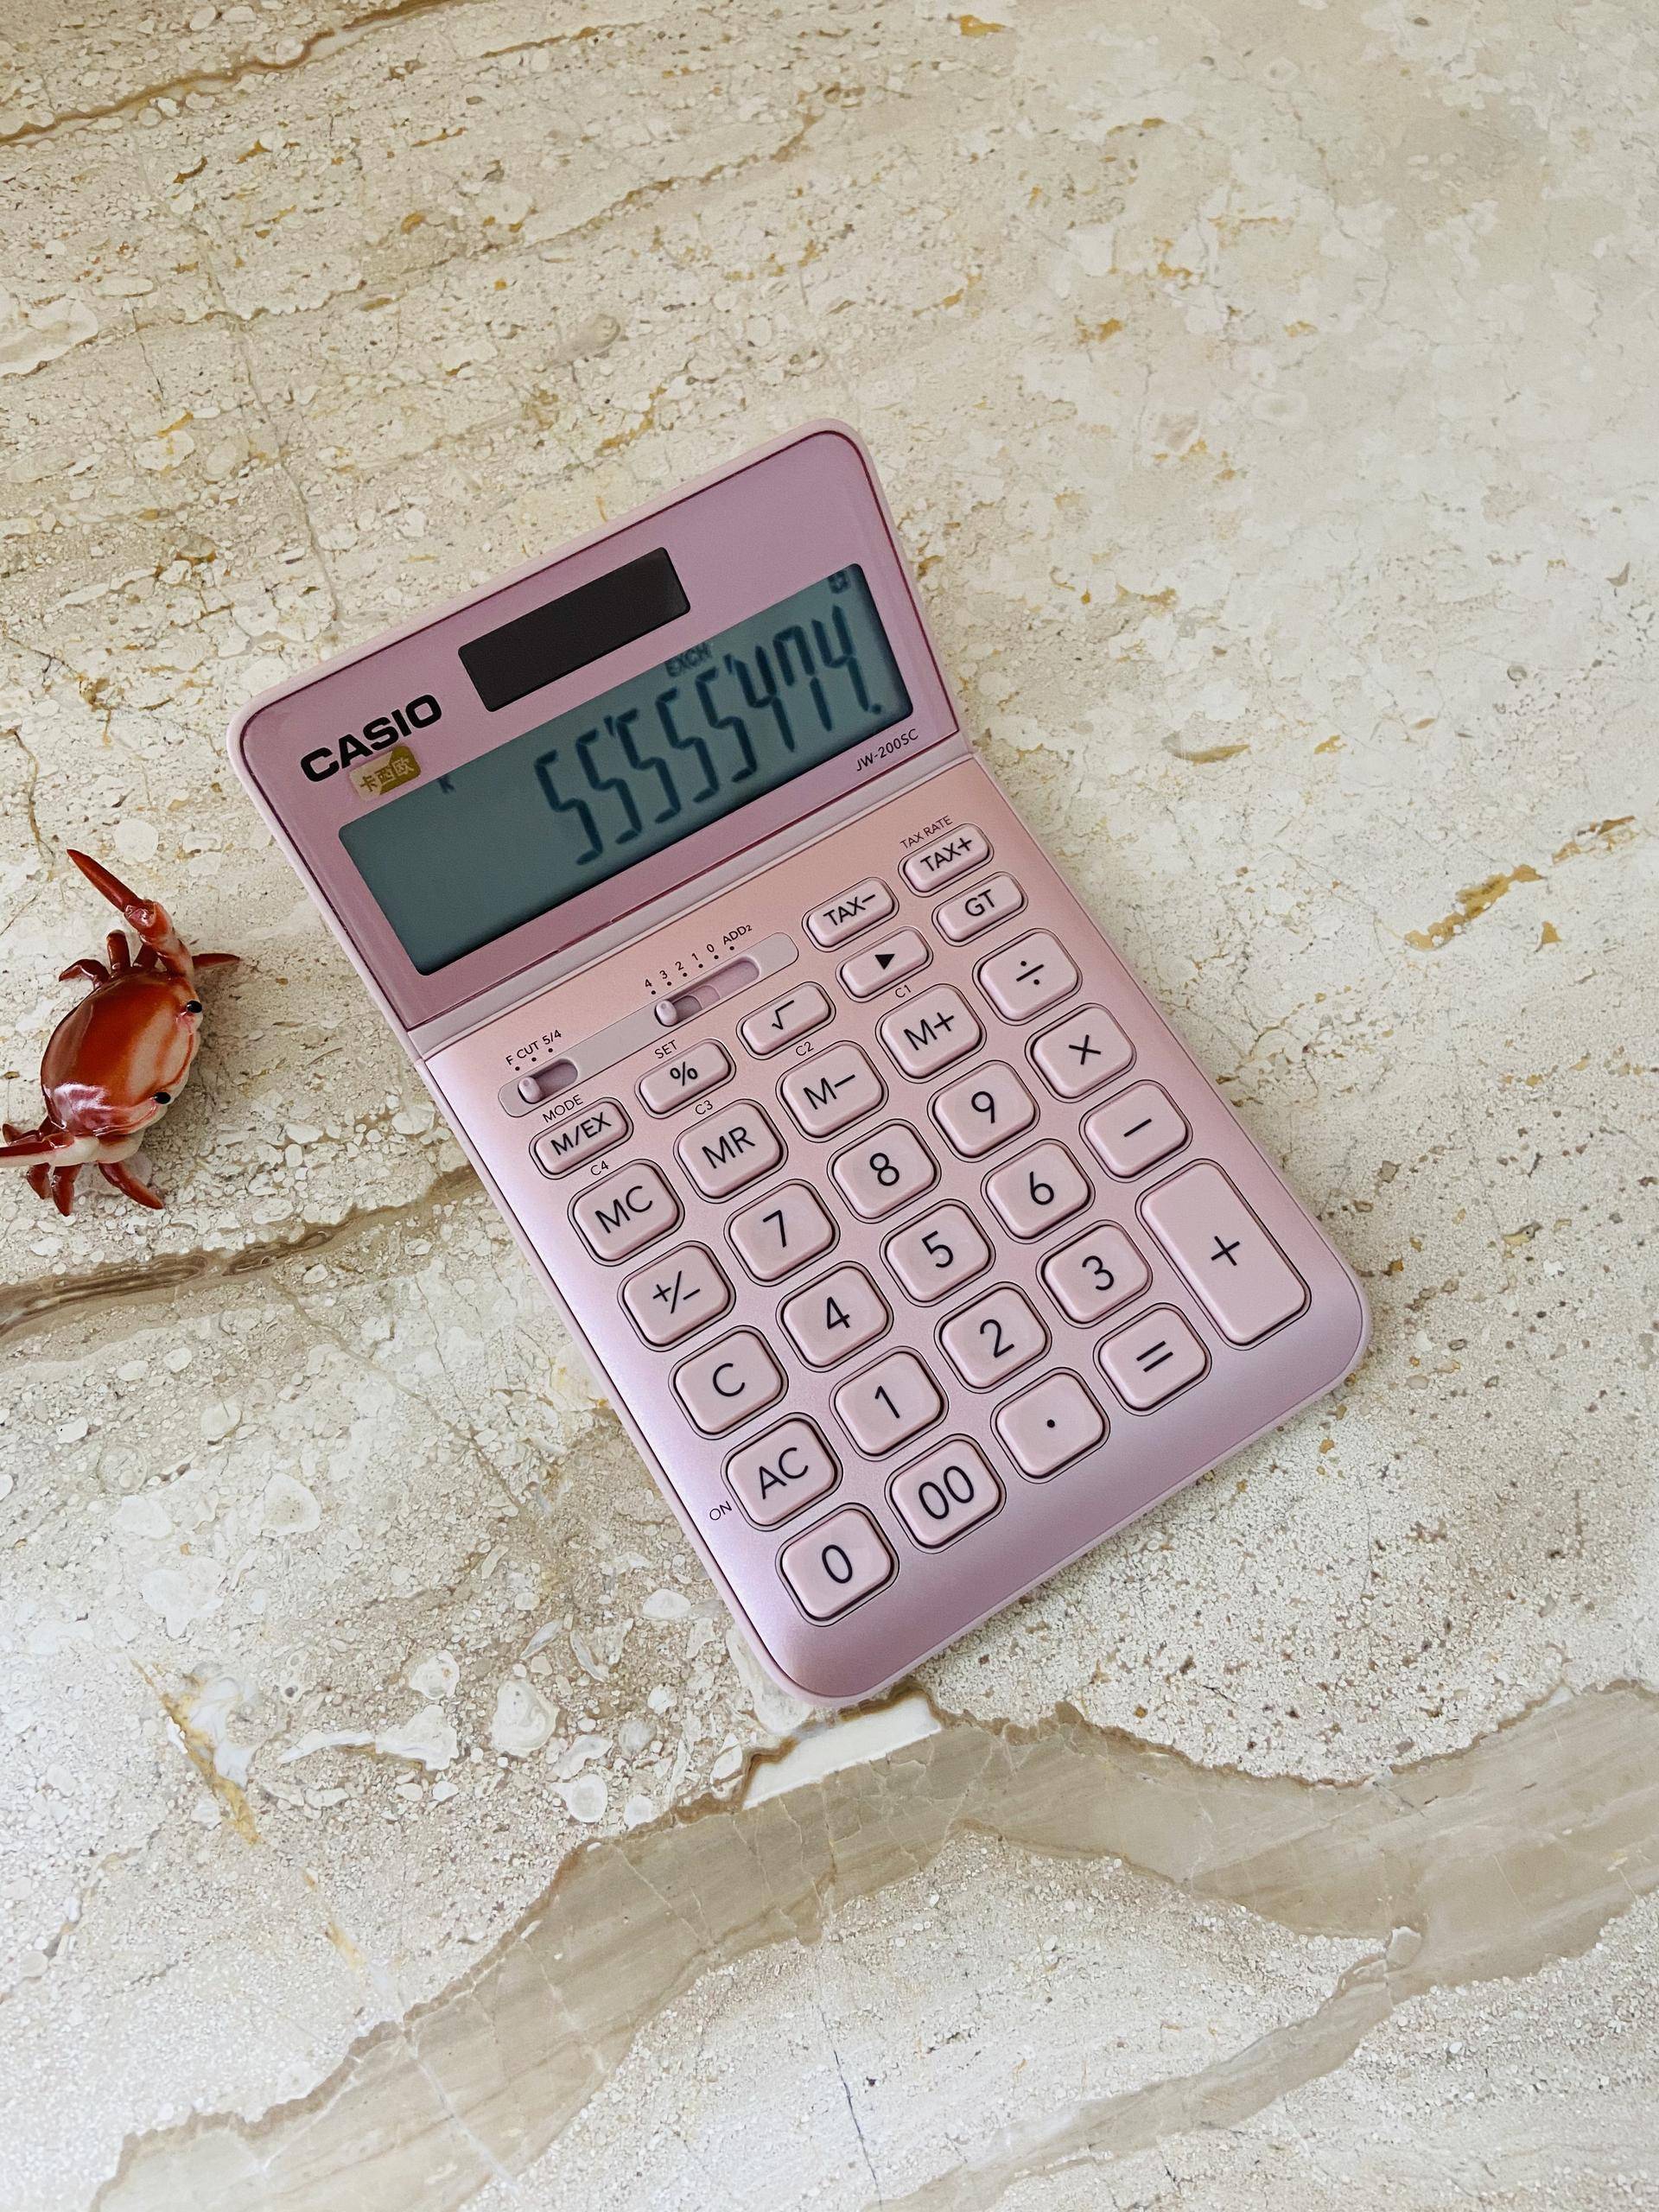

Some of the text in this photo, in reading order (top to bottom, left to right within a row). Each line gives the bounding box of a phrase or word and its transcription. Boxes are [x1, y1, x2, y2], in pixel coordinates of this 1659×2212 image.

[301, 694, 442, 782] CASIO
[856, 728, 918, 771] JW-200SC
[359, 757, 415, 792] 卡西欧
[899, 816, 953, 849] TAX RATE
[920, 836, 972, 872] TAX+
[964, 889, 995, 916] GT
[645, 979, 652, 988] 4
[660, 970, 667, 980] 3
[676, 961, 684, 970] 2
[692, 952, 699, 961] 1
[707, 944, 715, 953] 0
[894, 984, 912, 998] C1
[505, 1030, 562, 1065] F CUT 5/4
[795, 1041, 814, 1057] C2
[903, 1012, 955, 1051] M+
[655, 1039, 677, 1060] SET
[670, 1061, 698, 1086] %
[542, 1095, 584, 1123] MODE
[695, 1100, 714, 1116] C3
[971, 1091, 995, 1123] 9
[550, 1112, 612, 1156] M/EX
[702, 1126, 755, 1168] MR
[590, 1160, 609, 1176] C4
[869, 1153, 899, 1186] 8
[1029, 1171, 1054, 1205] 6
[594, 1185, 653, 1234] MC
[763, 1210, 788, 1249] 7
[922, 1230, 953, 1268] 5
[1082, 1255, 1114, 1291] 3
[825, 1297, 850, 1331] 4
[980, 1319, 1014, 1358] 2
[713, 1363, 745, 1397] C
[874, 1385, 900, 1419] 1
[759, 1446, 809, 1499] AC
[918, 1465, 975, 1520] 00
[709, 1500, 732, 1522] ON
[822, 1544, 853, 1584] 0
